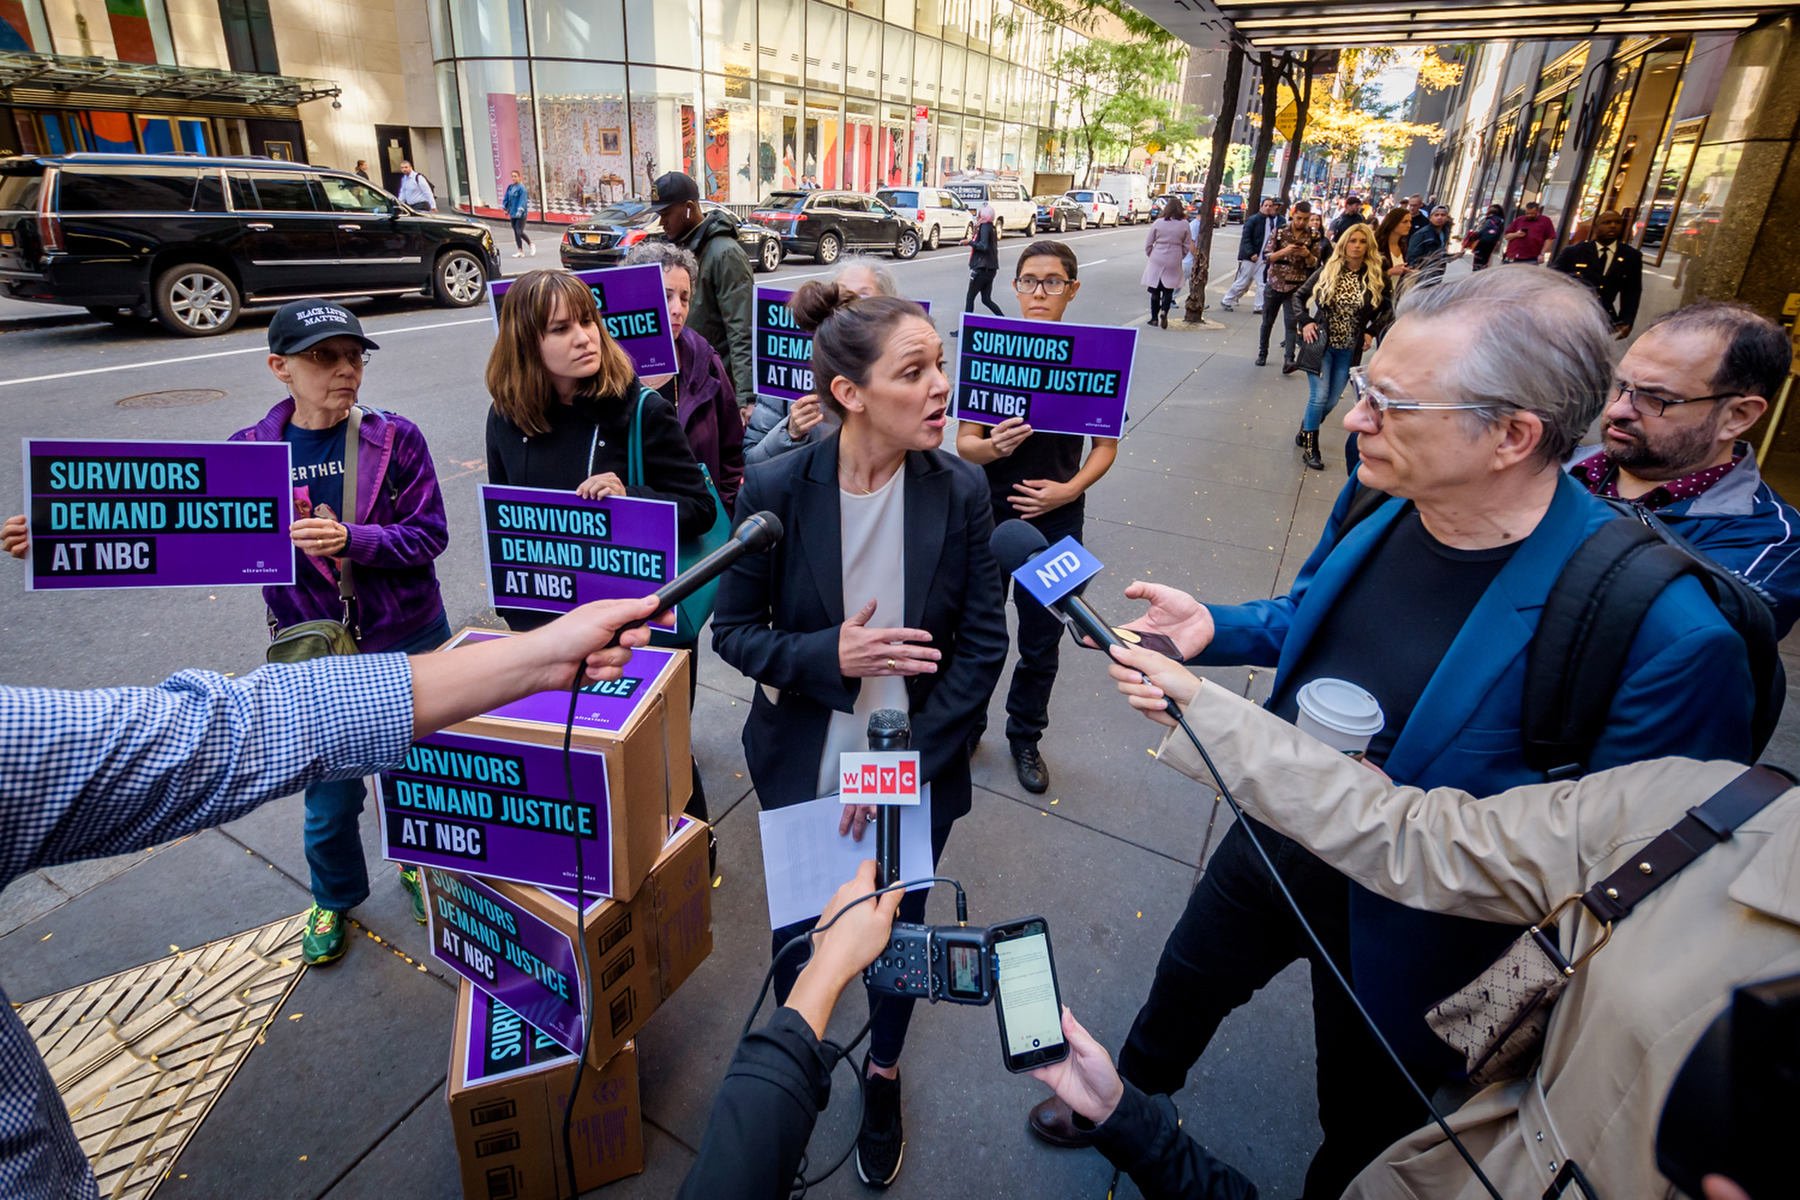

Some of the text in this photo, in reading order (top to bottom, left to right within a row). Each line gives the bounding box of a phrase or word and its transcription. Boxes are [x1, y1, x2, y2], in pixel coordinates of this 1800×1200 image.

[296, 307, 325, 320] BLACK
[303, 315, 347, 326] MATTER
[602, 312, 658, 338] STICE
[767, 335, 814, 361] DEMA
[972, 331, 1070, 361] SURVIVORS
[767, 364, 817, 391] AT NB
[970, 360, 1117, 395] DEMAND JUSTICE
[968, 389, 1027, 417] AT NBC
[50, 461, 200, 490] SURVIVORS
[51, 501, 273, 530] DEMAND JUSTICE
[498, 504, 607, 537] SURVIVORS
[52, 542, 150, 571] AT NBC
[501, 537, 662, 579] DEMAND JUSTICE
[1035, 551, 1081, 589] NTD
[505, 571, 573, 599] AT NBC
[401, 747, 520, 786] URVIVORS
[396, 780, 592, 834] DEMAND JUSTICE
[402, 818, 481, 855] AT NBC
[431, 868, 517, 935] SURVIVORS
[438, 895, 568, 999] DEMAND JUSTICE
[443, 927, 495, 980] AT NBC
